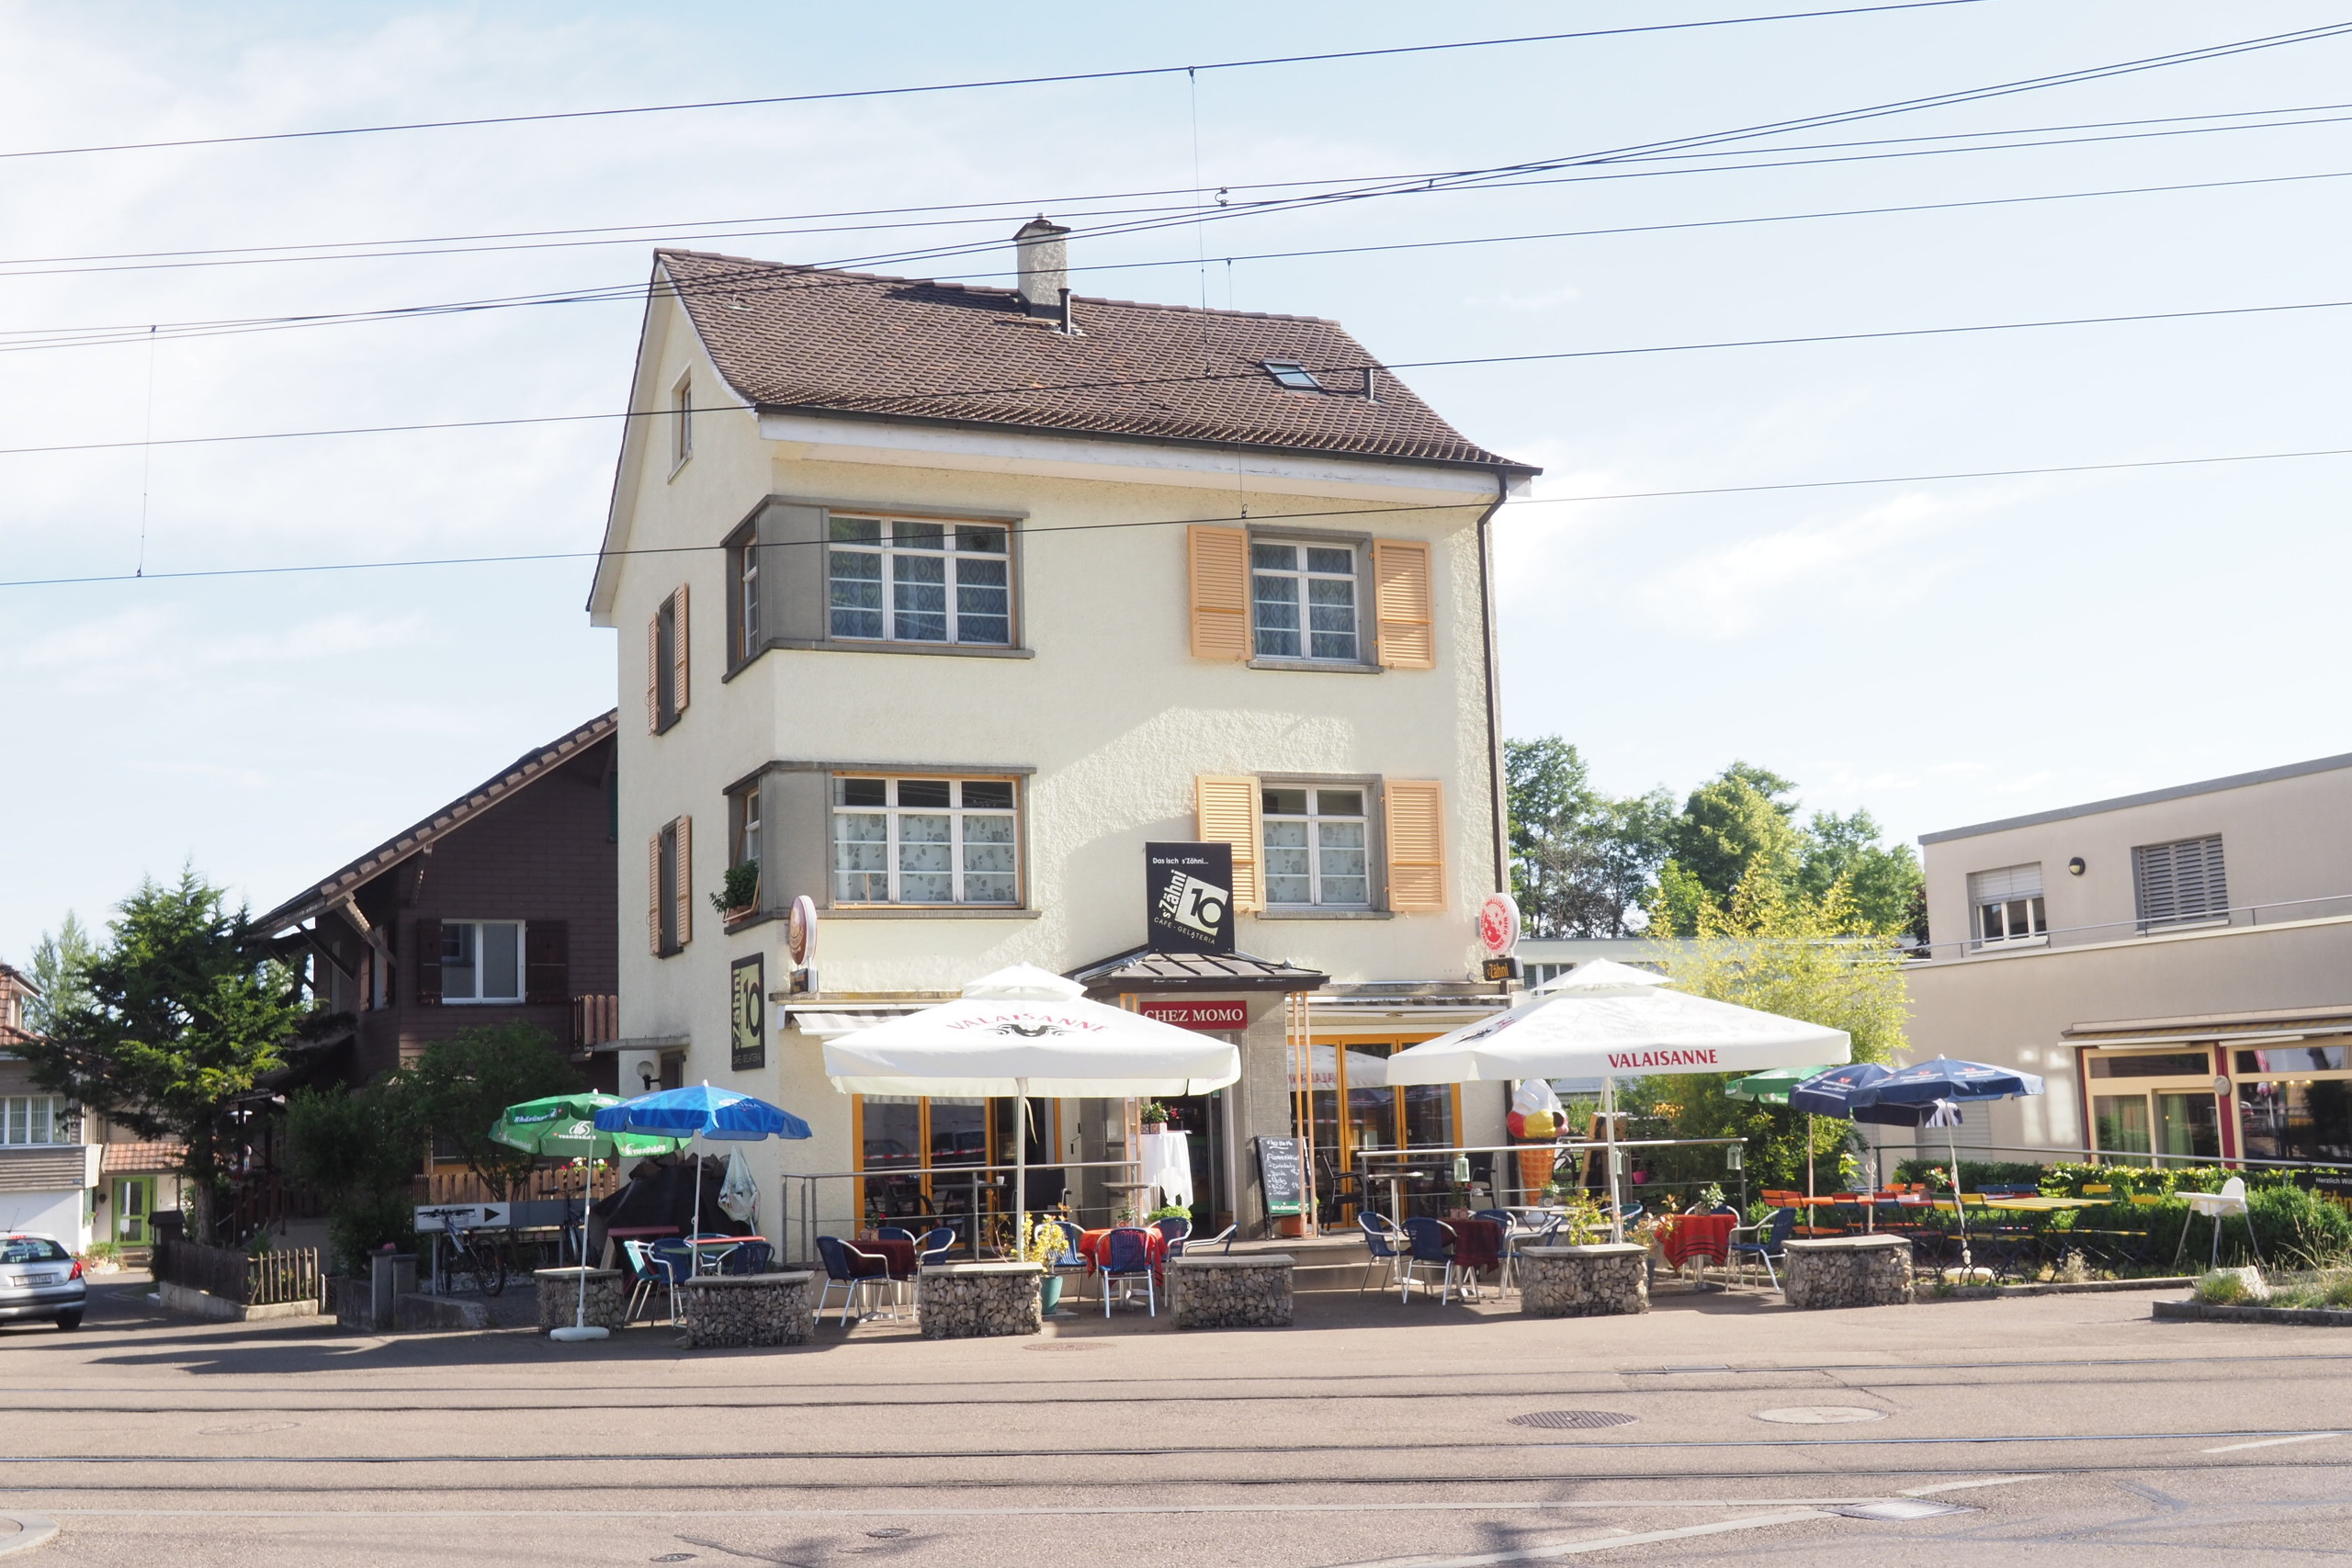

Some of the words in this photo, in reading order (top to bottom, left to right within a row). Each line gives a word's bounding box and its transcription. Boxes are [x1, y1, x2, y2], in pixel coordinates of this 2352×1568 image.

[1190, 887, 1226, 929] 10
[1154, 917, 1172, 928] CAFE
[1177, 926, 1216, 944] GELATERIA
[946, 1013, 1110, 1033] VALAISANNE
[1144, 1010, 1189, 1022] CHEZ
[1192, 1009, 1243, 1022] MOMO
[1608, 1049, 1718, 1068] VALAISANNE
